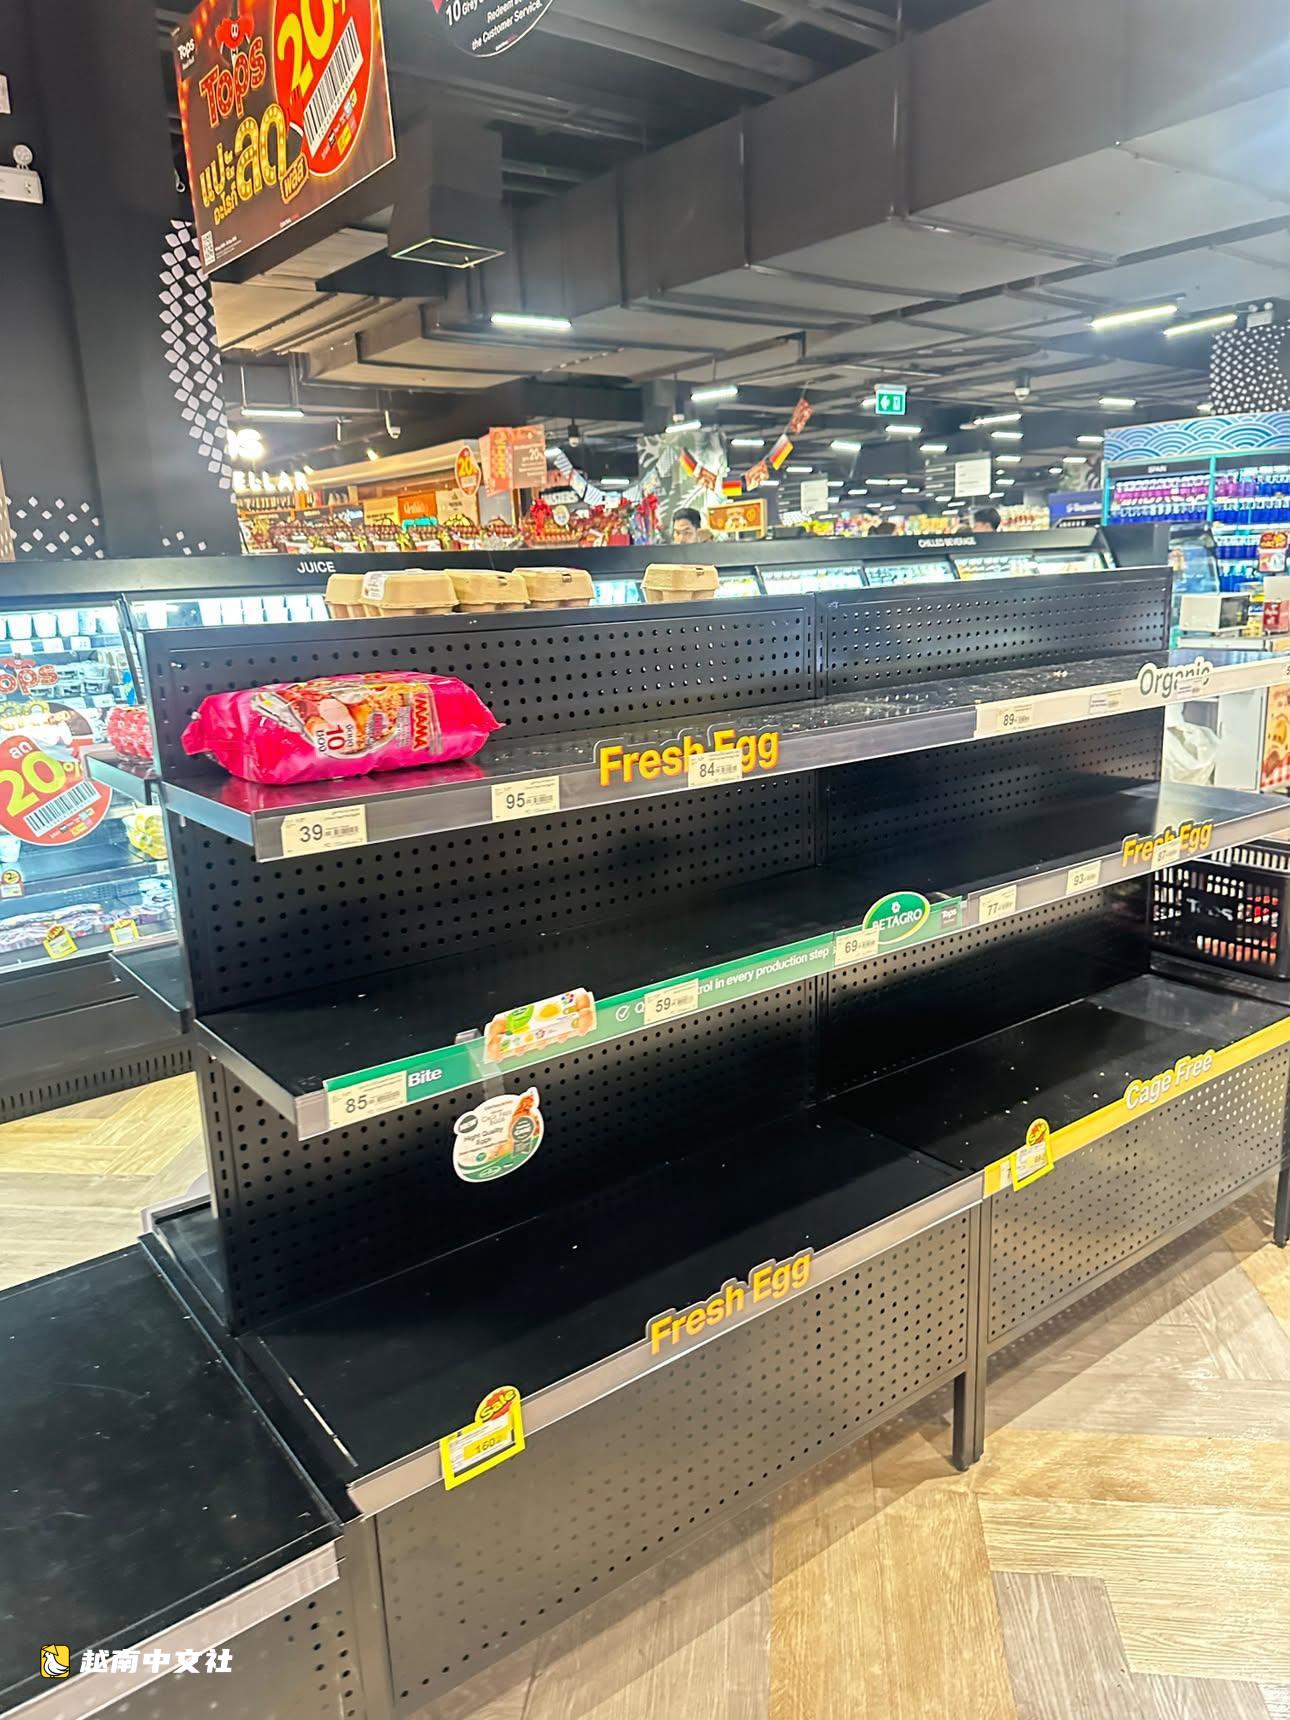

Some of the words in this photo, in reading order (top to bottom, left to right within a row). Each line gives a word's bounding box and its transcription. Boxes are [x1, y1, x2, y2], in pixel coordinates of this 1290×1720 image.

[446, 0, 461, 26] 10
[472, 38, 482, 50] the
[482, 16, 514, 42] Customer
[199, 36, 267, 128] Tops
[232, 470, 310, 494] ELLAR
[297, 561, 336, 574] JUICE
[0, 664, 58, 696] ops
[413, 692, 431, 751] MAMA
[1003, 713, 1015, 726] 89
[325, 724, 345, 750] 10
[699, 762, 715, 778] 84
[506, 792, 526, 809] 95
[300, 823, 323, 842] 39
[1180, 823, 1213, 854] Egg
[872, 908, 922, 931] BETAGRO
[987, 901, 998, 915] 77
[845, 940, 857, 954] 69
[715, 978, 725, 989] in
[726, 969, 753, 986] every
[756, 953, 807, 979] production
[809, 947, 829, 962] step
[655, 997, 671, 1013] 59
[408, 1068, 442, 1088] Bite
[1126, 1074, 1171, 1110] Cage
[1175, 1055, 1213, 1086] Free
[345, 1094, 368, 1113] 85
[651, 1285, 745, 1355] Fresh
[752, 1253, 812, 1304] Egg
